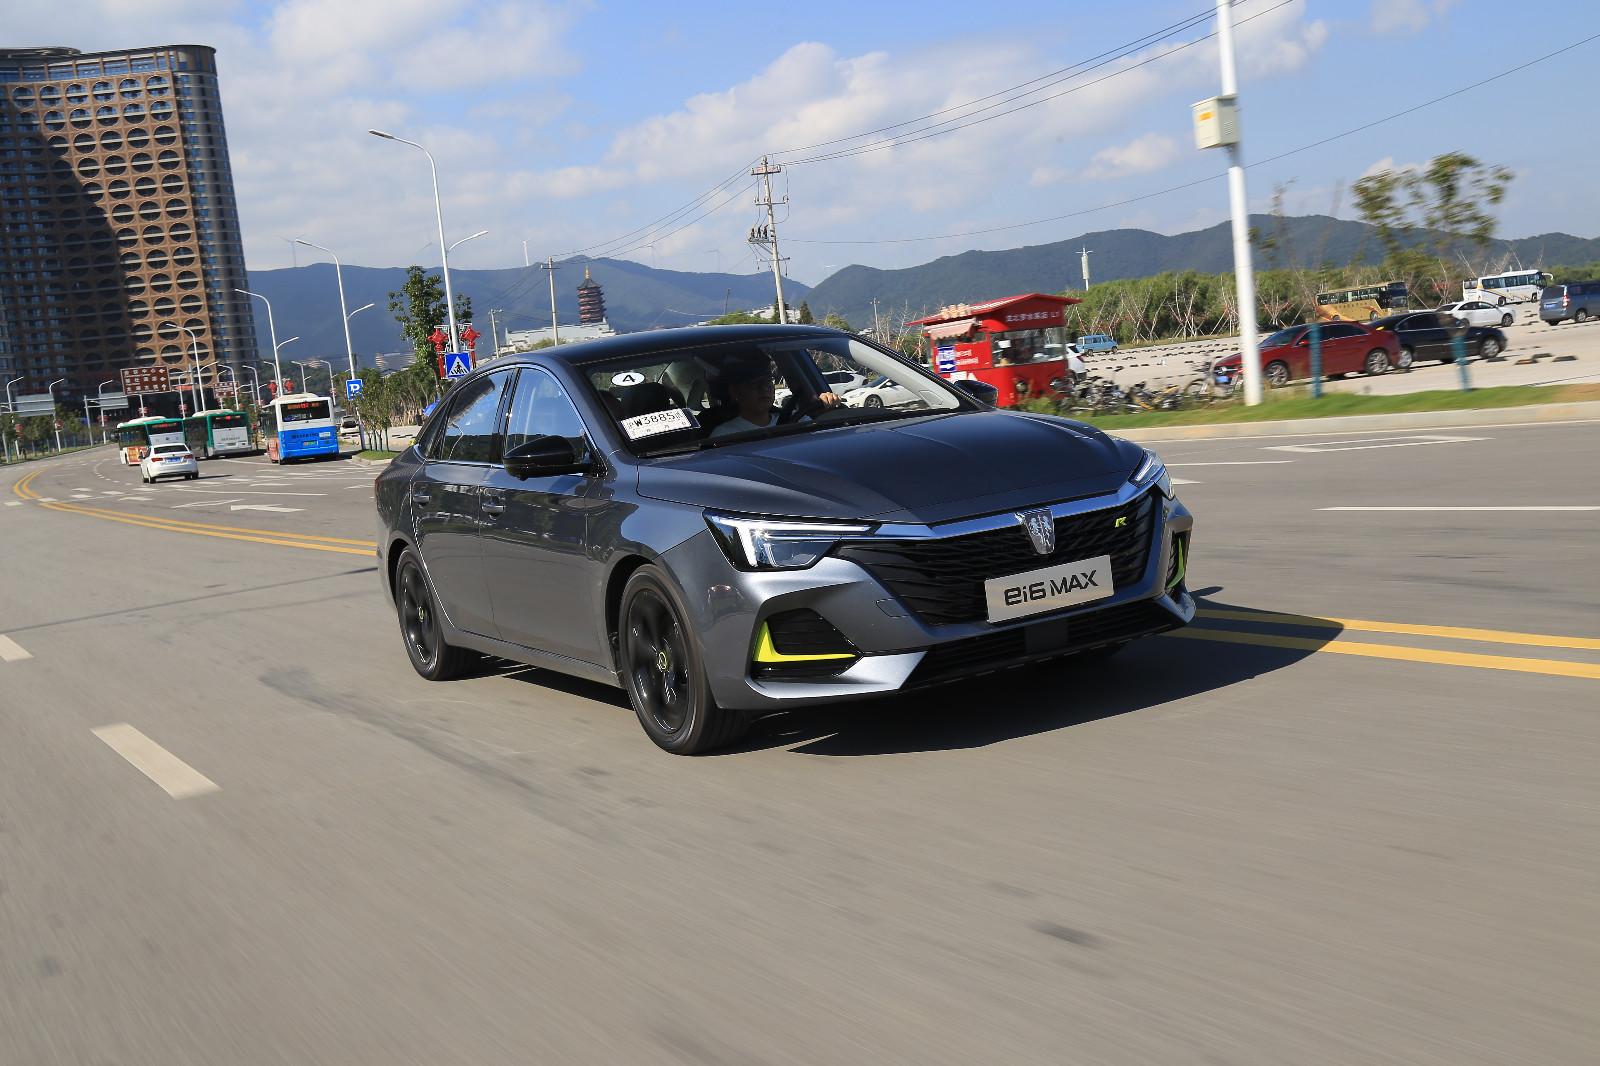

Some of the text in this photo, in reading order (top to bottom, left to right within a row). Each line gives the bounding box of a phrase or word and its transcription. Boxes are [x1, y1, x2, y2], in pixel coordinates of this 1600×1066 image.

[622, 374, 635, 383] A
[349, 384, 360, 393] P
[634, 412, 676, 427] W3885
[1049, 569, 1099, 597] MAX
